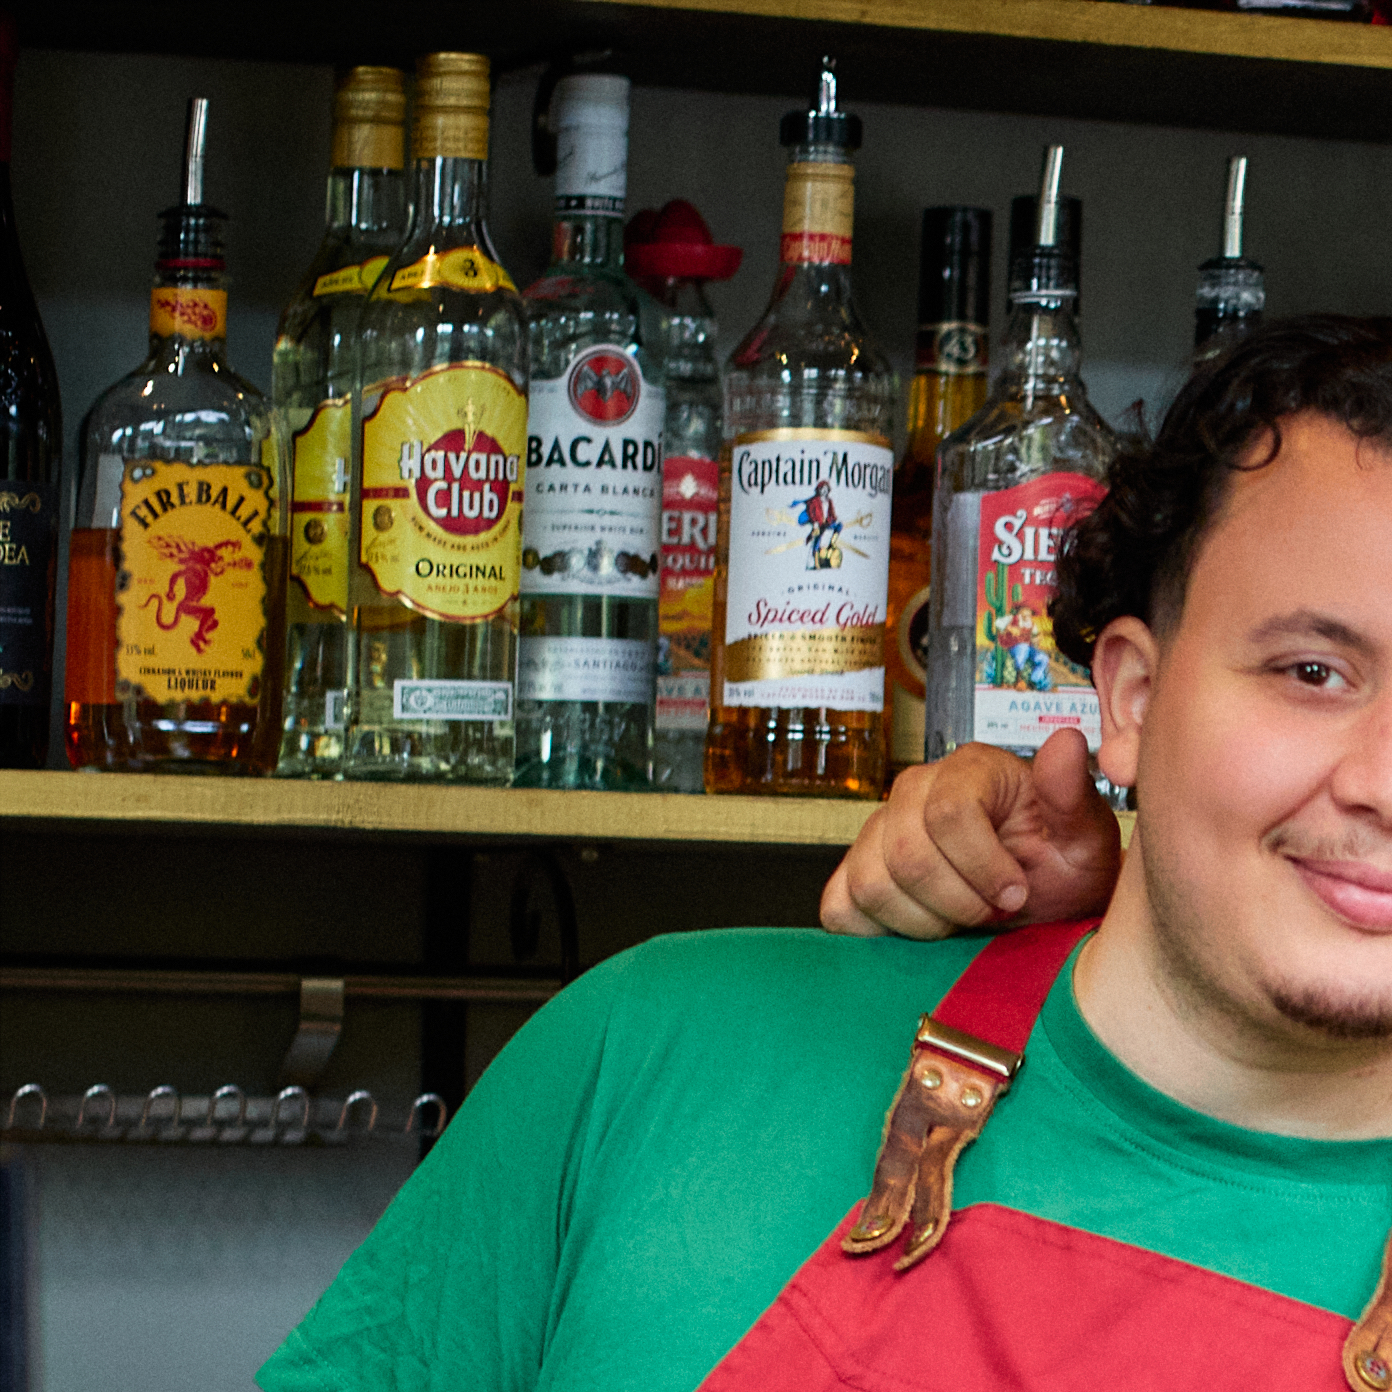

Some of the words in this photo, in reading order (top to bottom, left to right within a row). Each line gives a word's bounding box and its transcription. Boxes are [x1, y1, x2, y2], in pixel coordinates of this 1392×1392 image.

[463, 258, 477, 278] 3
[400, 440, 519, 482] Havana
[737, 449, 820, 494] Captain
[535, 483, 592, 494] CARTA
[129, 479, 259, 533] FIREBALL
[426, 481, 499, 519] Club
[415, 558, 505, 580] ORIGINAL
[788, 583, 849, 596] ORIGINAL
[748, 598, 830, 628] Spiced
[836, 601, 878, 631] Gold
[167, 677, 216, 692] LIQUEUR
[1009, 700, 1062, 713] AGAVE
[1070, 702, 1101, 714] AZU
